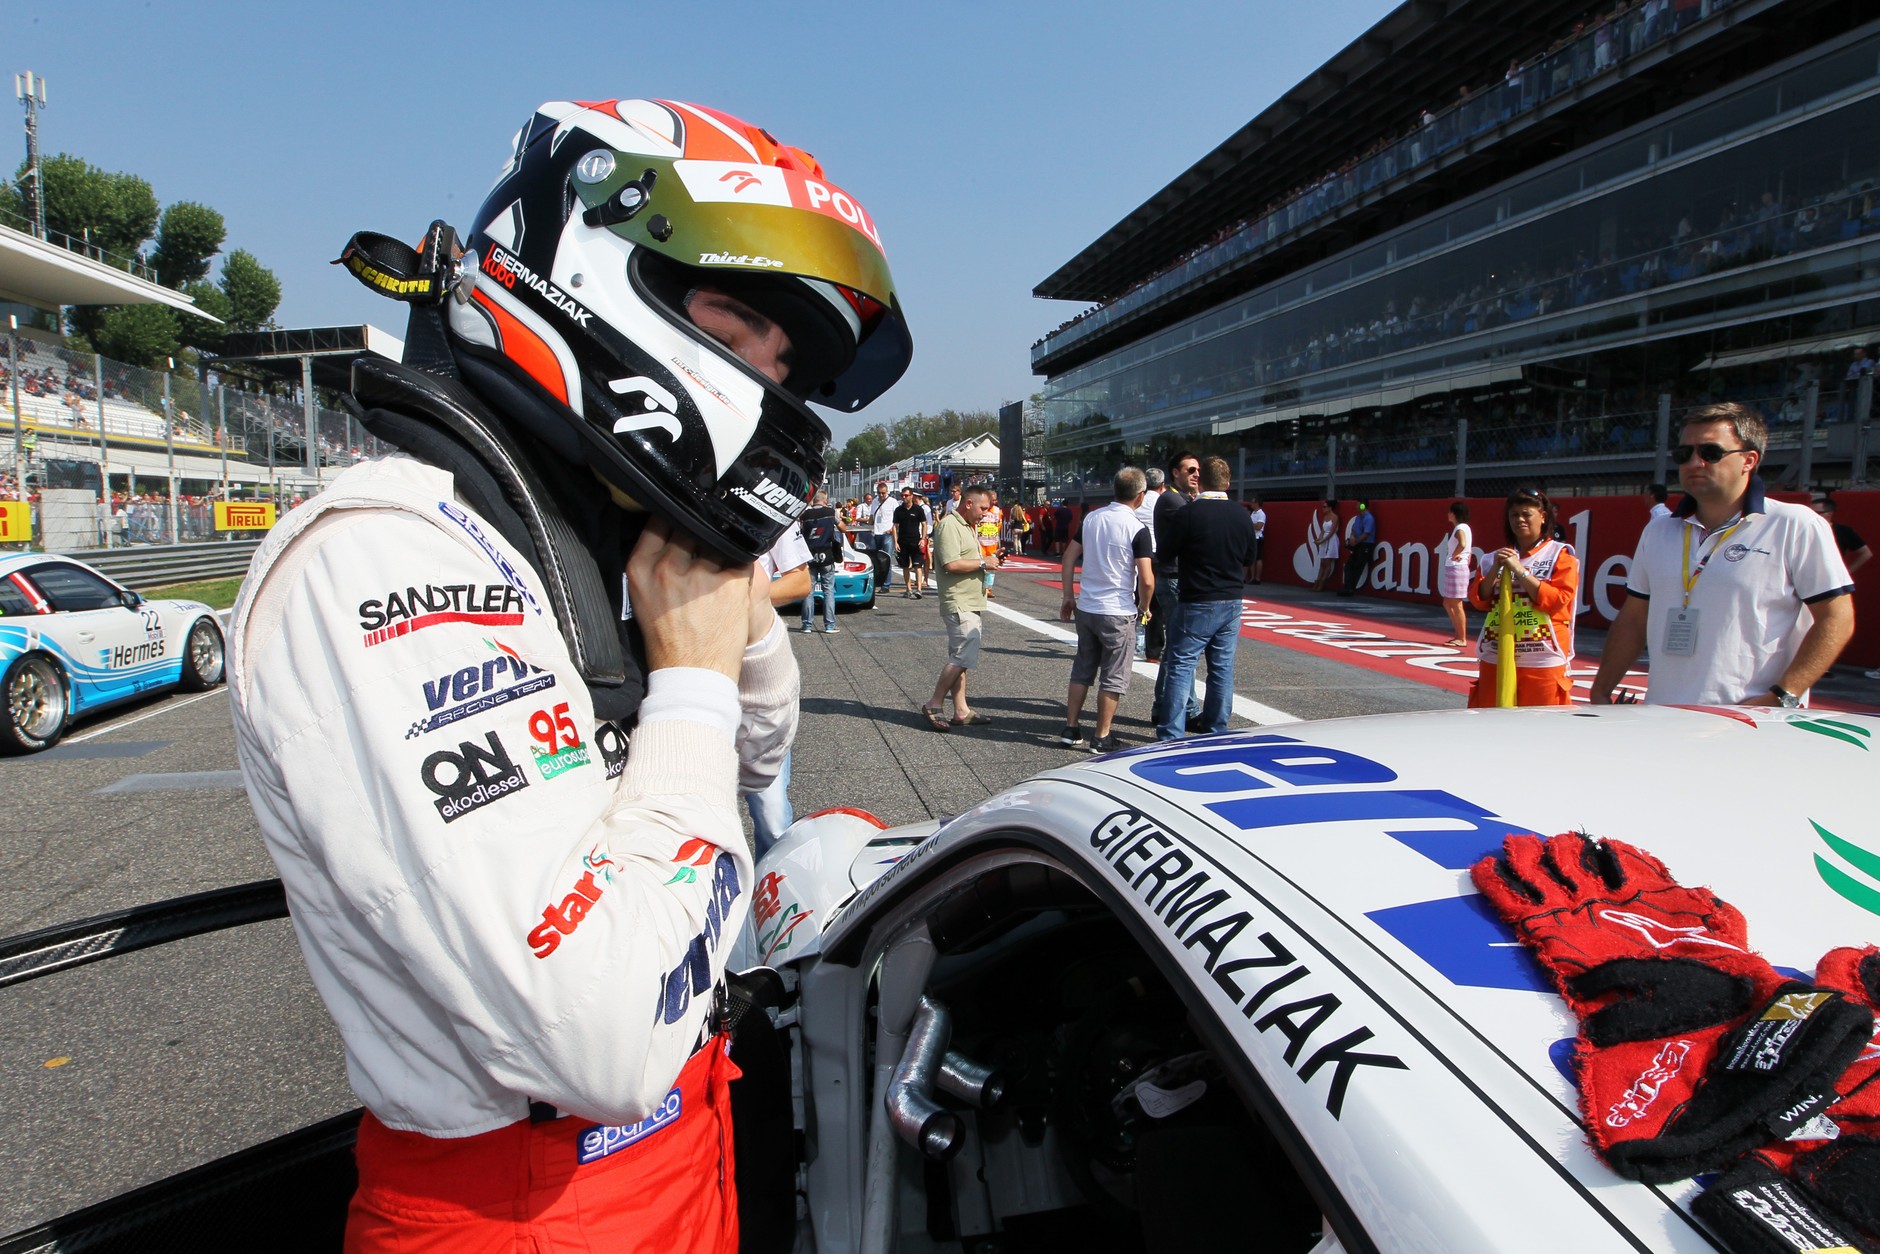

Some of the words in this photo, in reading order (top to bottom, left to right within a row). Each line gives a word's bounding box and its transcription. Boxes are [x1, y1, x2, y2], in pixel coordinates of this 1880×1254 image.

[805, 180, 883, 248] POLA
[350, 256, 431, 294] SCHROTH
[492, 247, 594, 329] GIERMAZIAK
[226, 506, 266, 526] PIRELLI
[753, 477, 807, 517] verv
[141, 610, 162, 632] 22
[359, 584, 524, 630] SANDTLER
[113, 639, 165, 668] Hermes
[528, 702, 581, 756] 95
[421, 730, 514, 797] ON
[541, 749, 590, 776] eurosup
[442, 767, 526, 818] ekodiesel
[527, 871, 604, 960] star
[1090, 808, 1411, 1122] GIERMAZIAK
